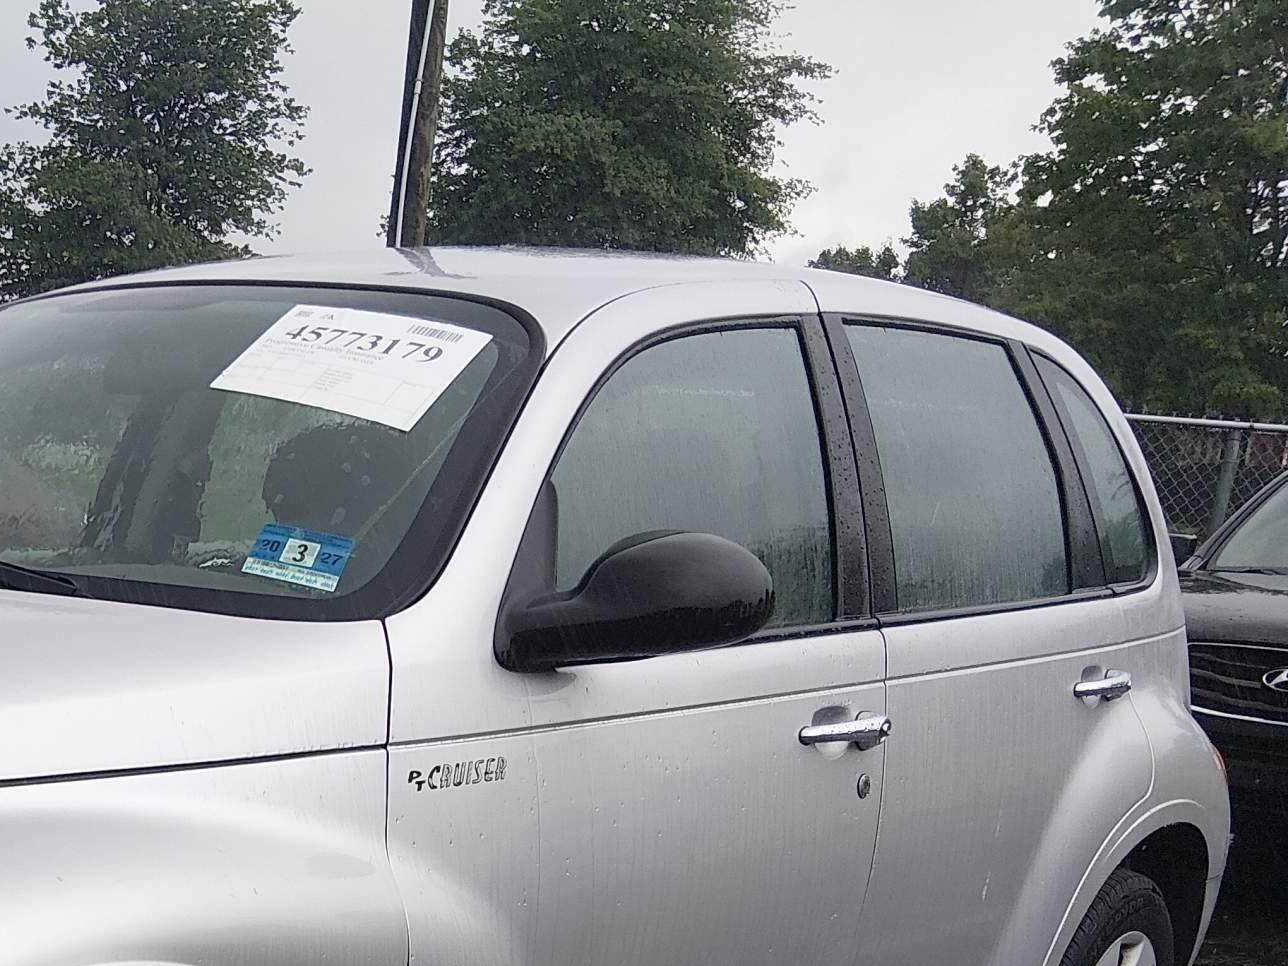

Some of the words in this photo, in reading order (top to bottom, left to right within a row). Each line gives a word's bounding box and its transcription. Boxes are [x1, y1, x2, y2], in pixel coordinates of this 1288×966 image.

[284, 324, 444, 363] 45773179
[260, 538, 281, 553] 20
[291, 543, 309, 563] 3
[320, 551, 344, 566] 27
[407, 770, 427, 792] PT
[427, 756, 508, 790] CRUISER
